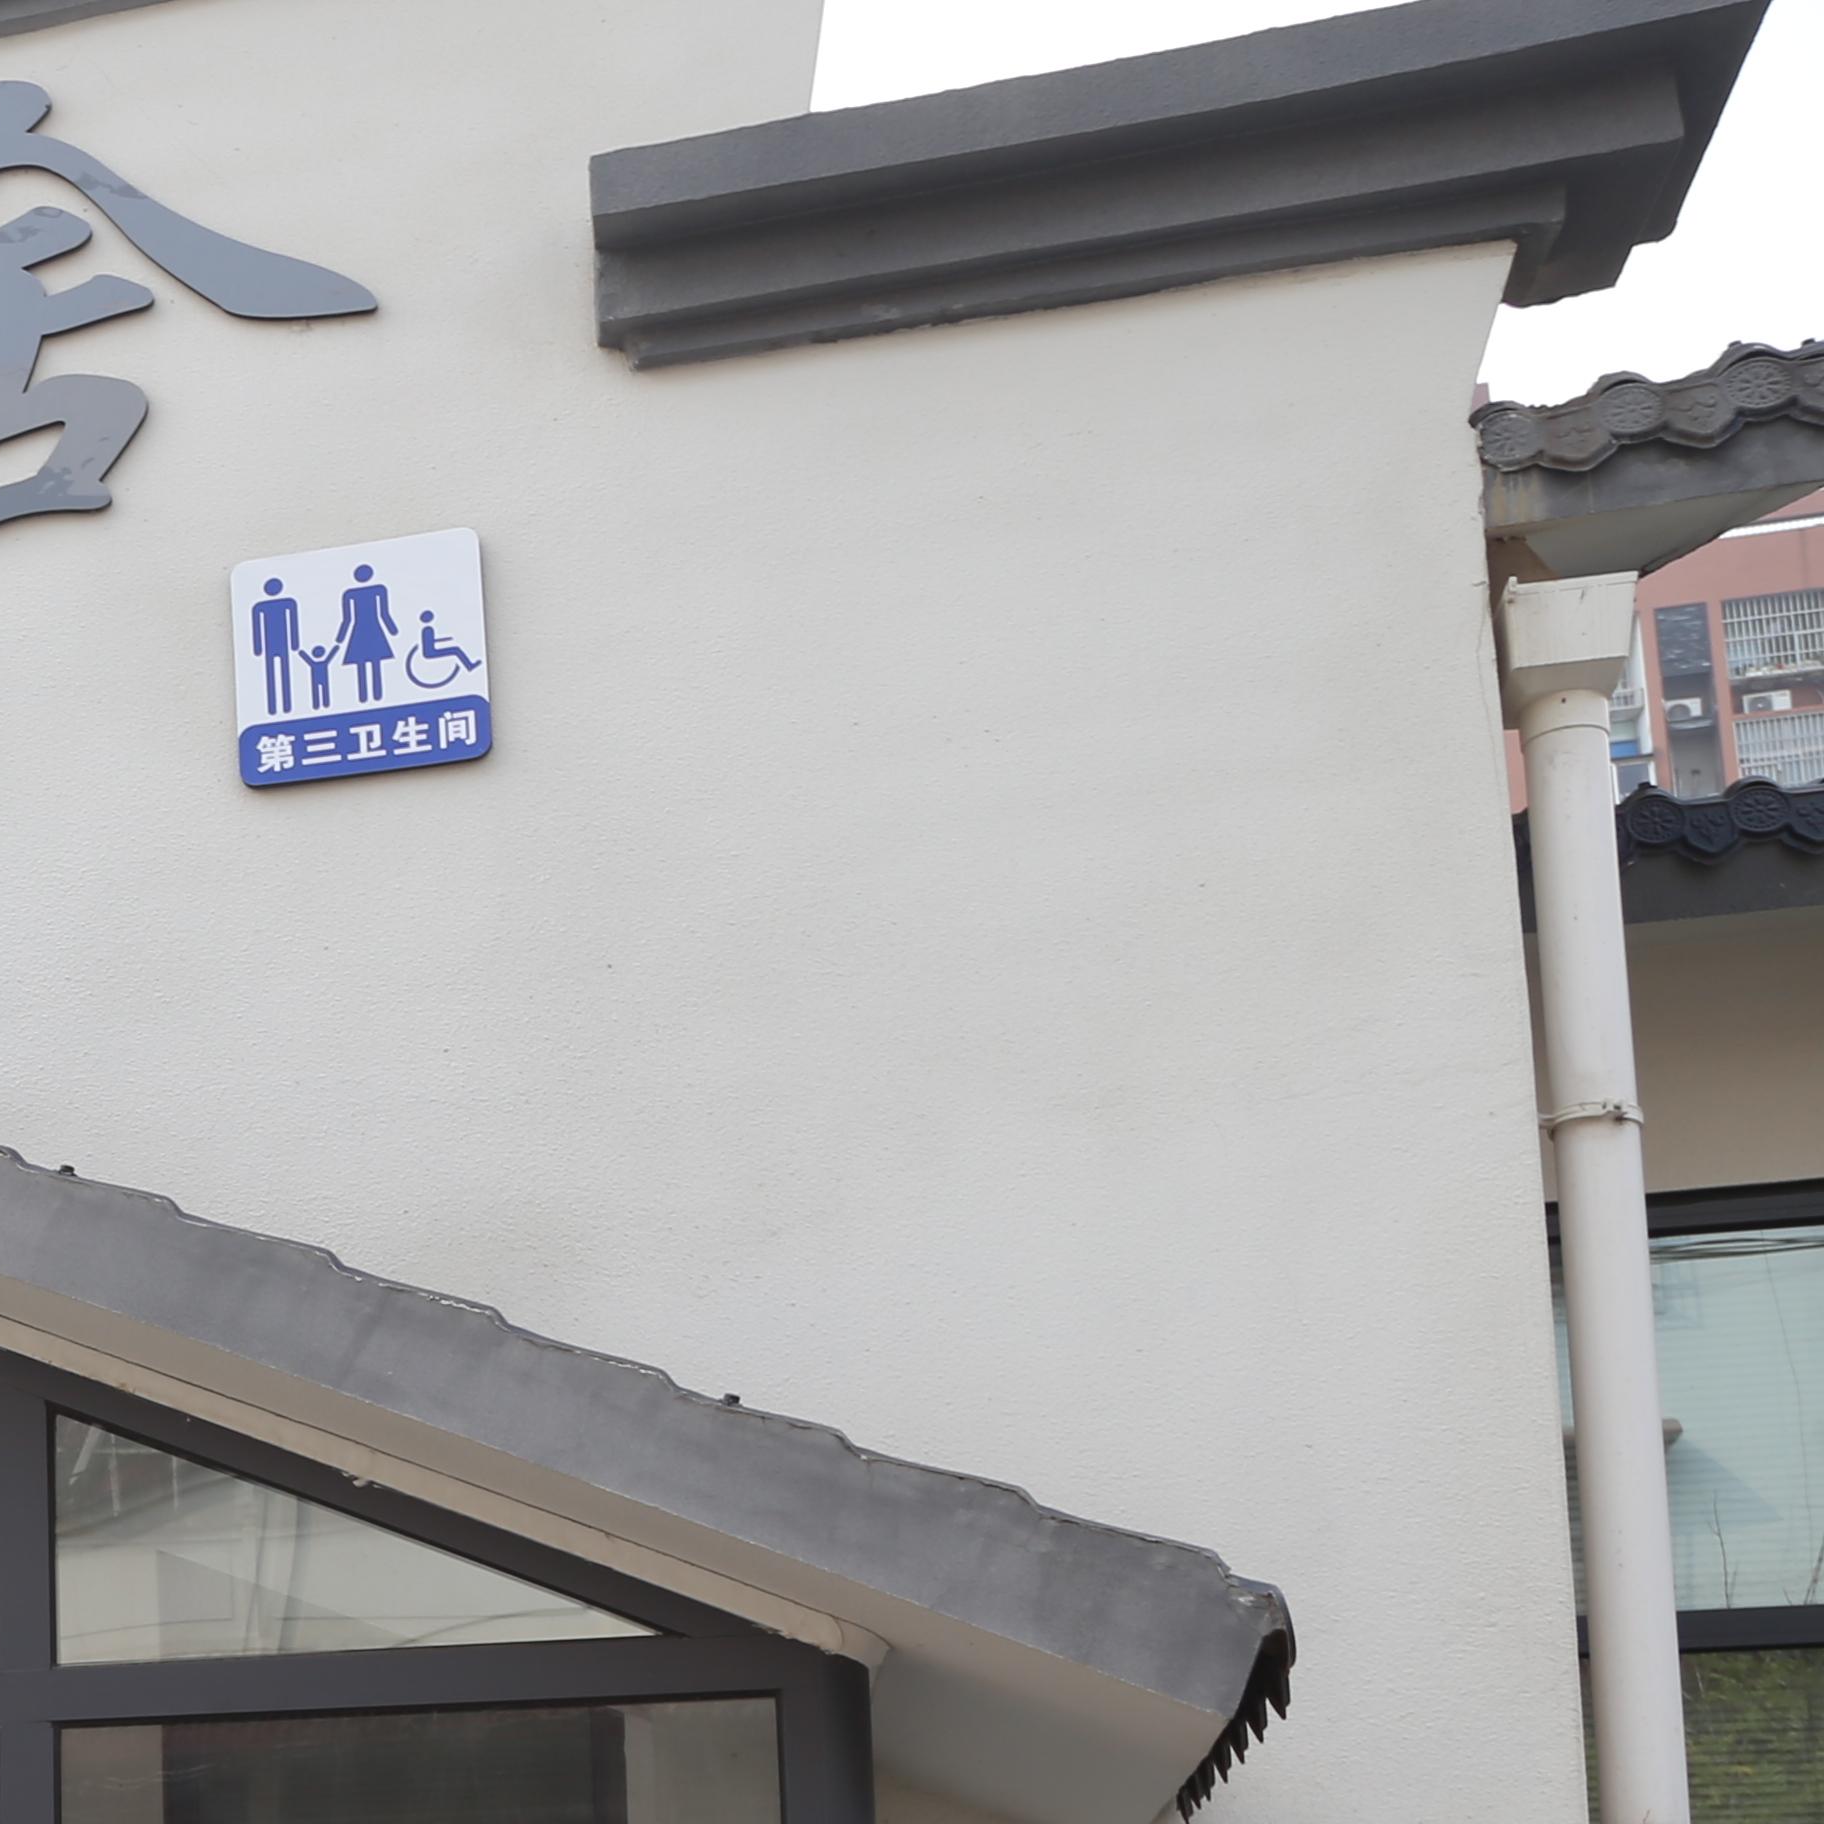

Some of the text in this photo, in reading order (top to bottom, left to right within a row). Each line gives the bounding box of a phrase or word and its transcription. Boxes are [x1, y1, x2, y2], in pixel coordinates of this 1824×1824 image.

[254, 708, 479, 777] 第三卫生间
